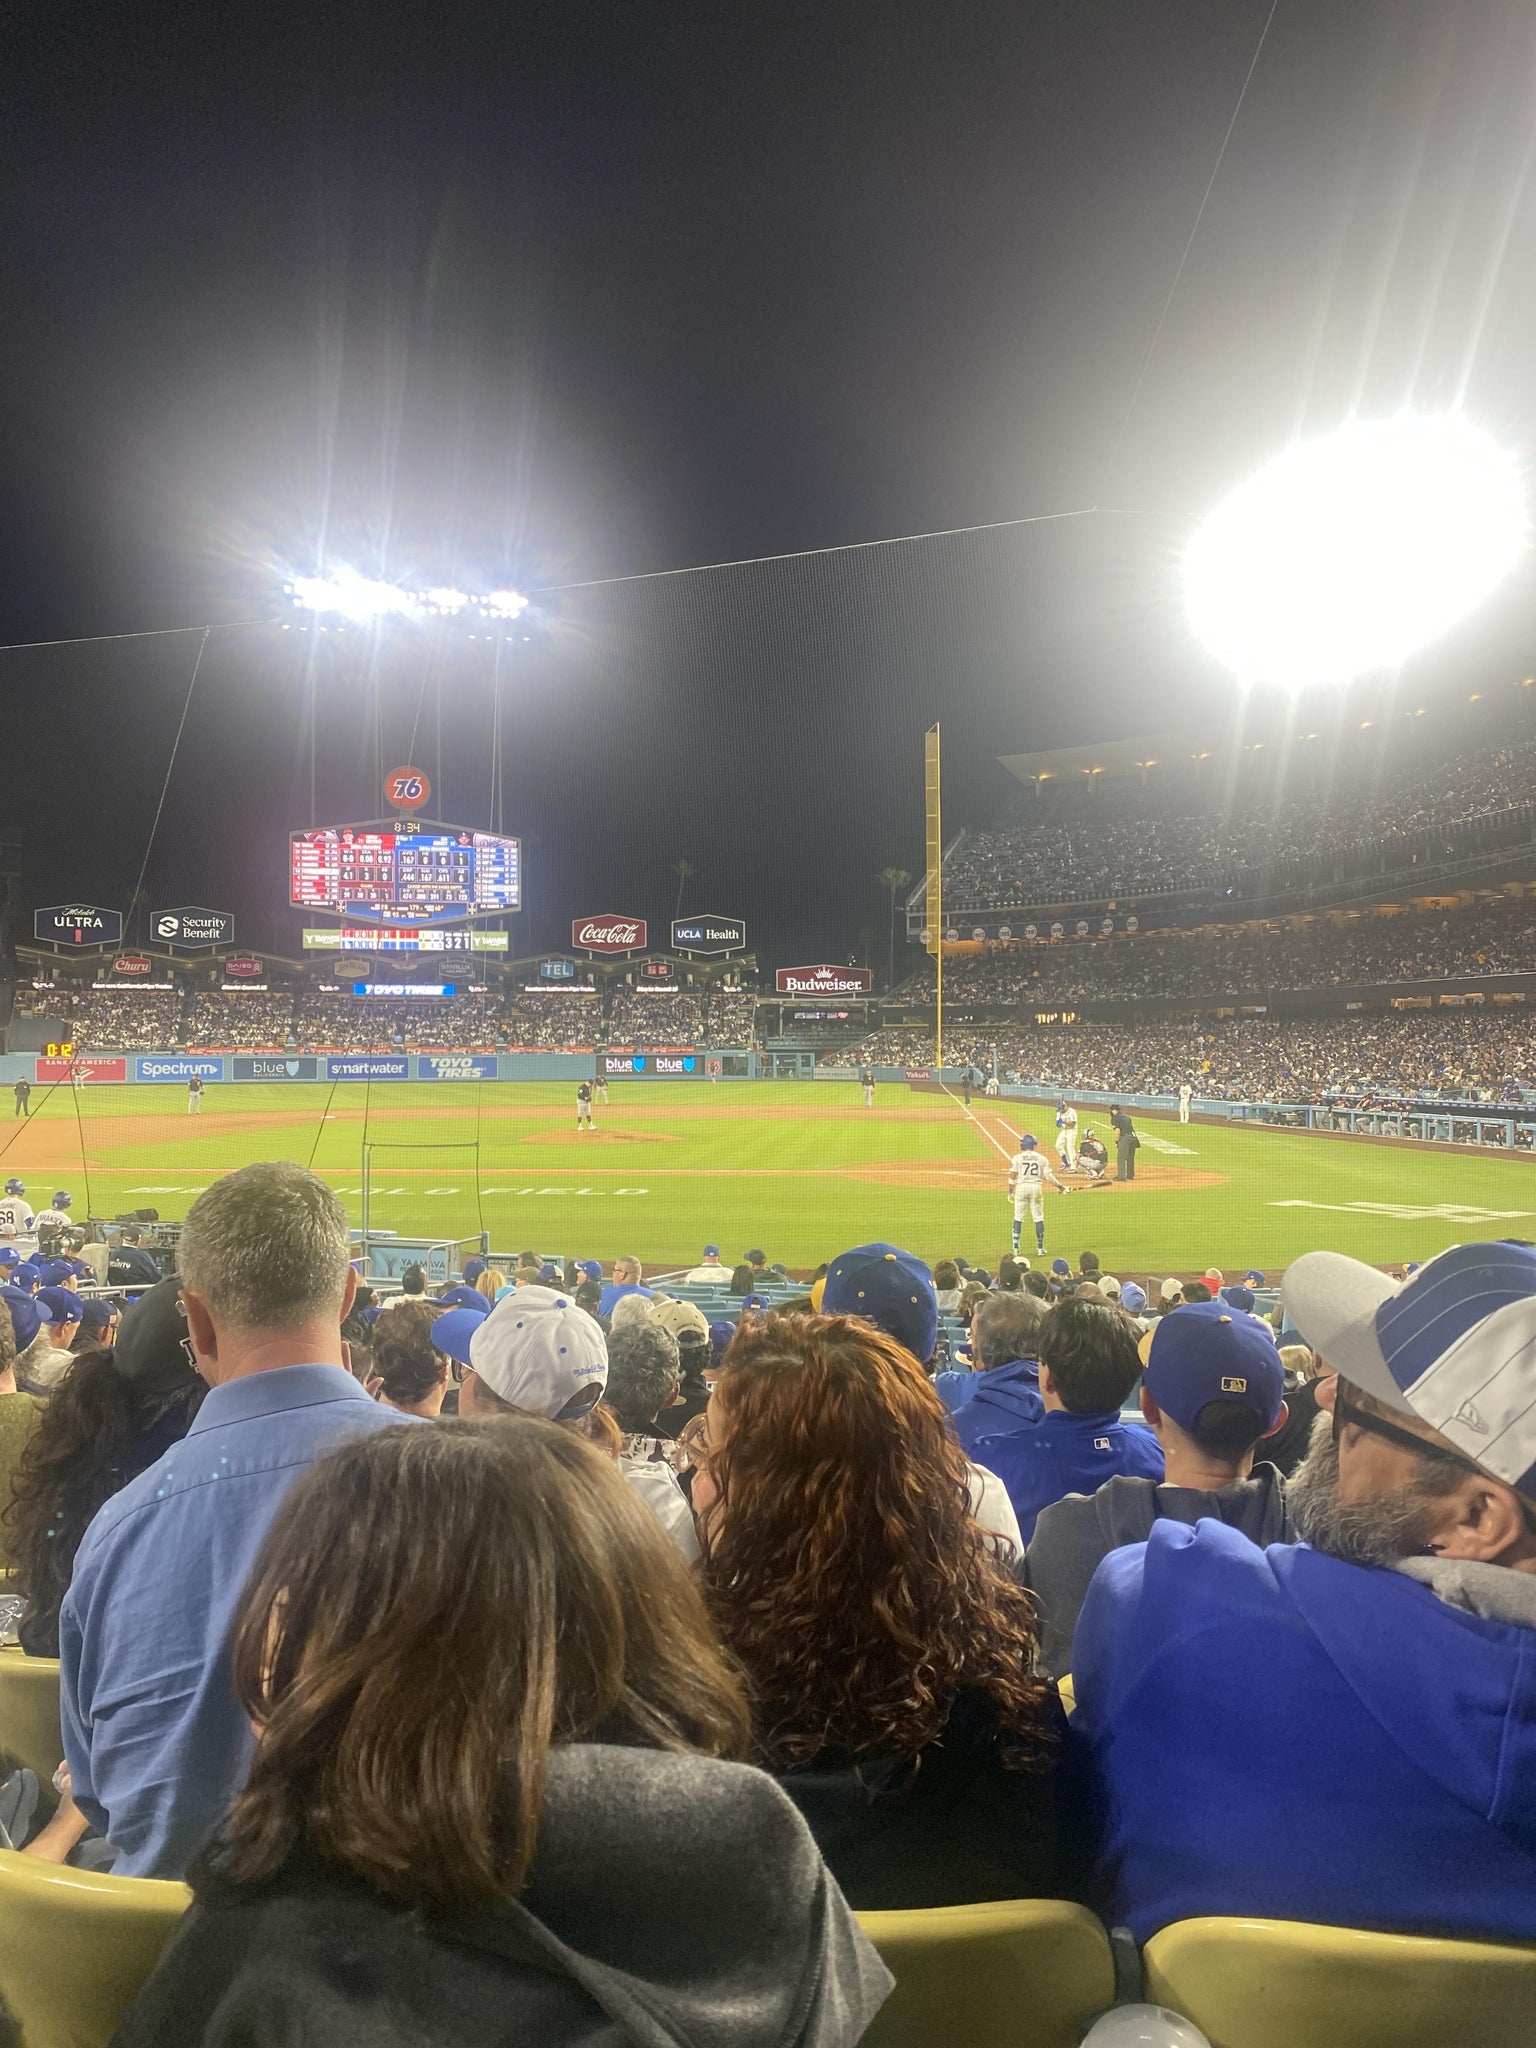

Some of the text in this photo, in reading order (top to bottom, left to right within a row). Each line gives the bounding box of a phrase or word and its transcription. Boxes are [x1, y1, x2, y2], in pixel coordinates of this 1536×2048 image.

[393, 777, 422, 799] 76
[394, 822, 420, 833] 8:34
[377, 855, 392, 864] 0.92
[400, 856, 414, 864] .167
[423, 856, 428, 865] 0
[441, 857, 446, 865] 0
[382, 873, 387, 881] 0
[419, 874, 432, 882] .167
[54, 916, 103, 928] ULTRA
[182, 916, 226, 928] Security
[182, 928, 220, 939] Benefit
[579, 923, 639, 944] Coca-Cola
[677, 929, 739, 940] UCLA Health
[445, 937, 452, 949] 3
[454, 937, 461, 949] 2
[464, 937, 469, 949] 1
[114, 959, 149, 971] Churu
[544, 965, 570, 976] TEL
[364, 984, 403, 996] TOYO
[47, 1043, 73, 1058] 0:12
[253, 1061, 284, 1074] blue
[331, 1061, 404, 1075] smartwater
[430, 1057, 473, 1068] TOYO
[605, 1057, 632, 1069] blue
[656, 1057, 683, 1069] blue
[141, 1062, 213, 1077] Spectrum
[436, 1067, 482, 1078] TIRES
[905, 1071, 930, 1079] Yakult
[1022, 1162, 1039, 1176] 72
